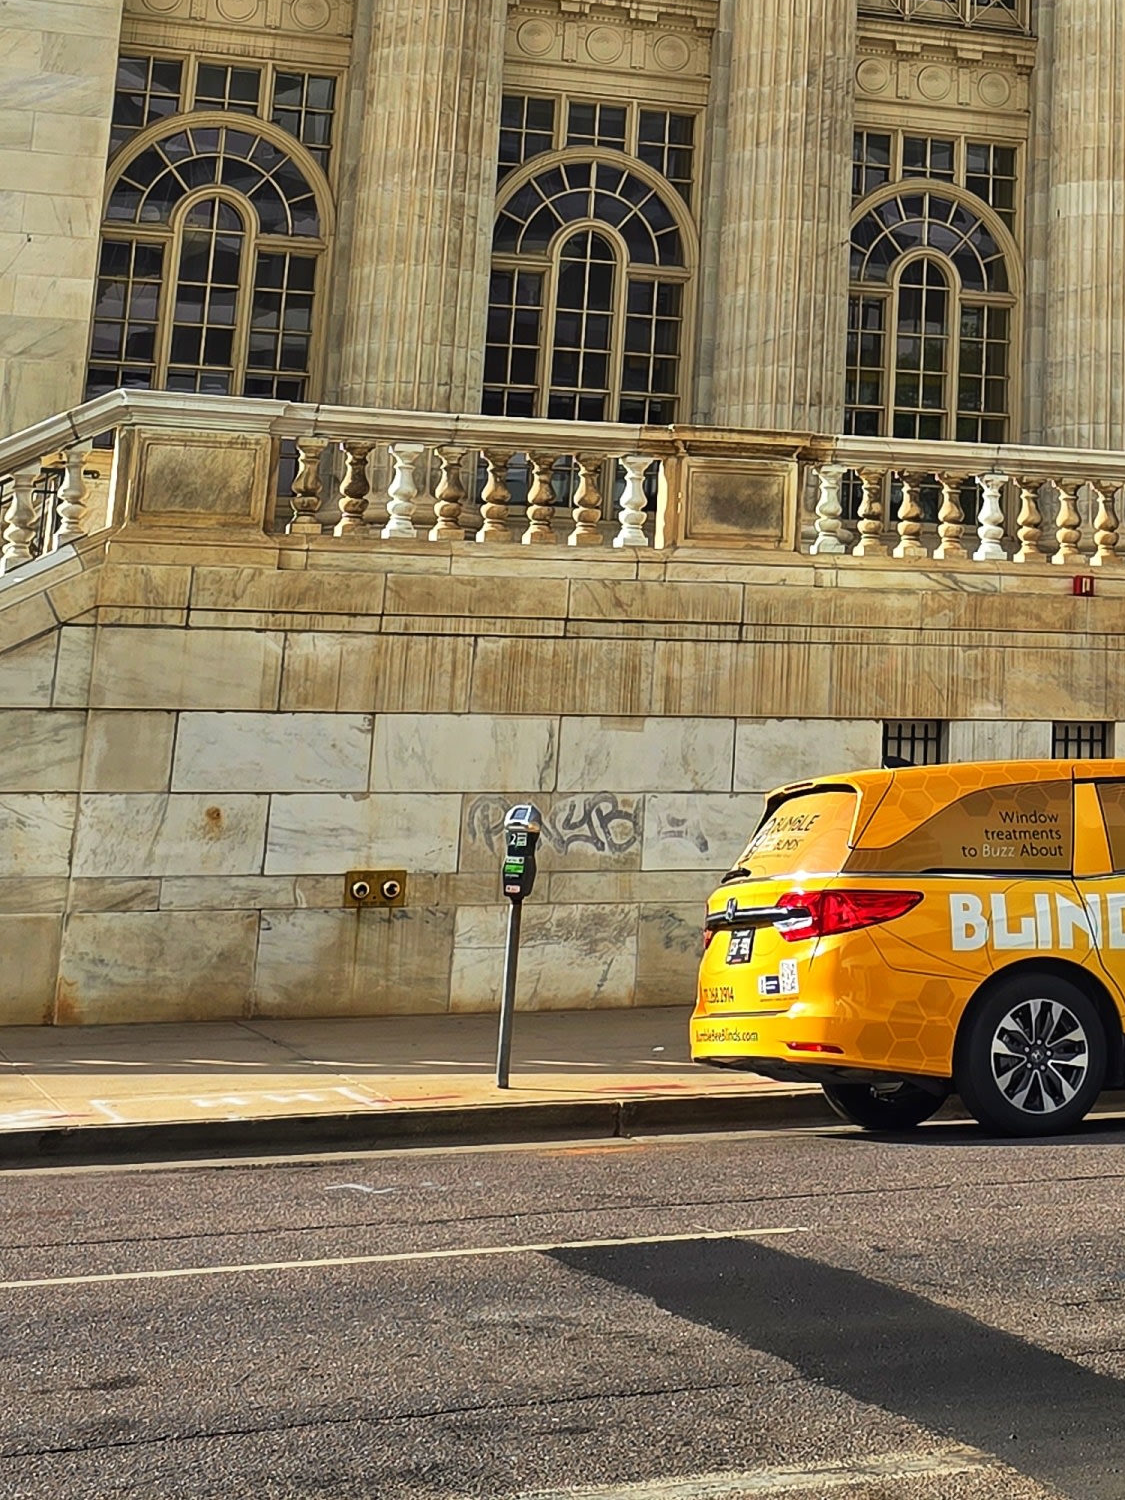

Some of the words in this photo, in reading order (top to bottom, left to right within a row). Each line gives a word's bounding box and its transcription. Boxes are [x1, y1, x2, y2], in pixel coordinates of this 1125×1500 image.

[999, 810, 1059, 824] Window
[984, 828, 1062, 840] treatments
[962, 846, 978, 858] to
[982, 843, 1016, 858] Buzz
[1020, 842, 1064, 857] About
